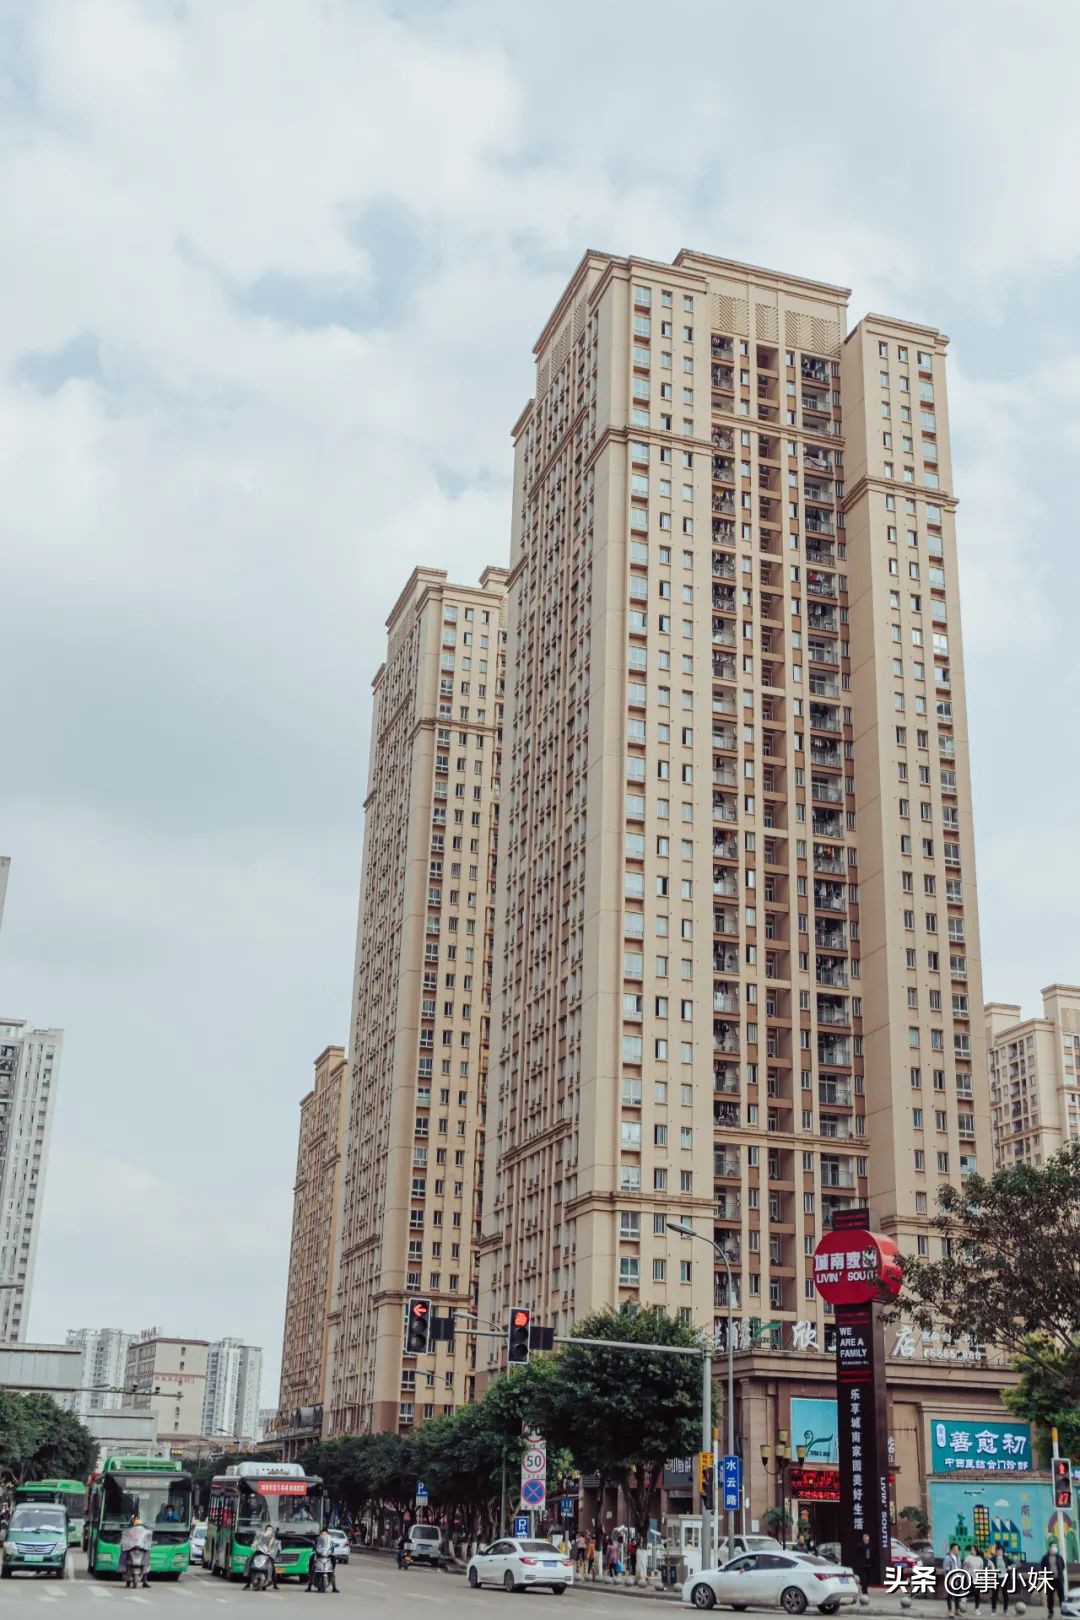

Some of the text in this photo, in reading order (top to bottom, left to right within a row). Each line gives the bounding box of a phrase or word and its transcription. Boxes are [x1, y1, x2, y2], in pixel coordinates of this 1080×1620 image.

[816, 1270, 878, 1284] LIVIN' SOU
[839, 1327, 852, 1336] WE
[840, 1338, 864, 1347] ARE A
[840, 1348, 867, 1358] FAMILY
[526, 1455, 542, 1468] 50
[850, 1388, 864, 1530] 乐享城南家园美好生活
[944, 1458, 1028, 1471] 中西医结合门诊部
[726, 1459, 737, 1506] 水云路
[518, 1518, 527, 1532] P
